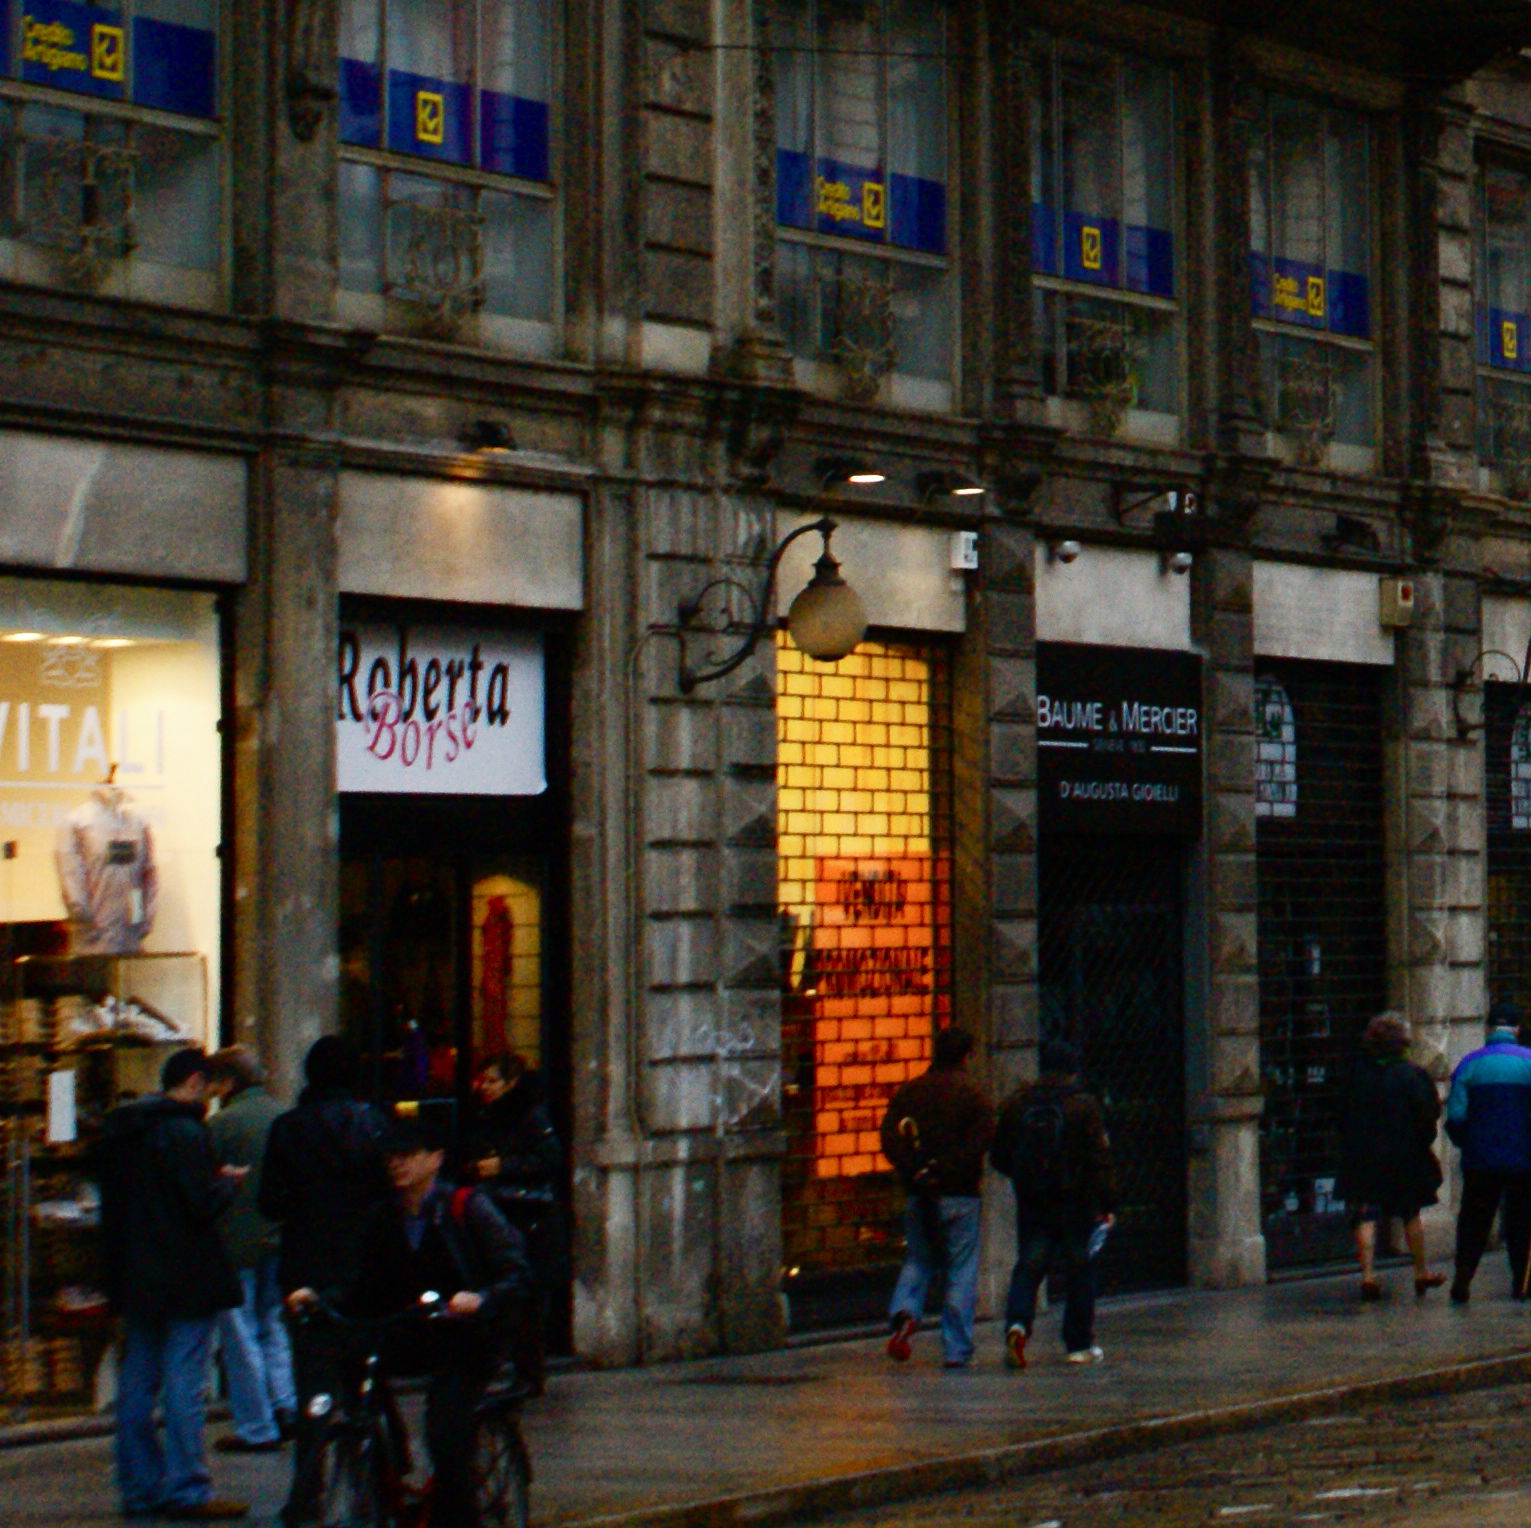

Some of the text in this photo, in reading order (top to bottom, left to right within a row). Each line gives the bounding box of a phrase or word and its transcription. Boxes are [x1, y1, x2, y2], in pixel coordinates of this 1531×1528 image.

[337, 624, 510, 726] Roberta
[1037, 694, 1103, 731] BAUME
[1122, 700, 1199, 735] MERCIER
[364, 690, 478, 770] Borse
